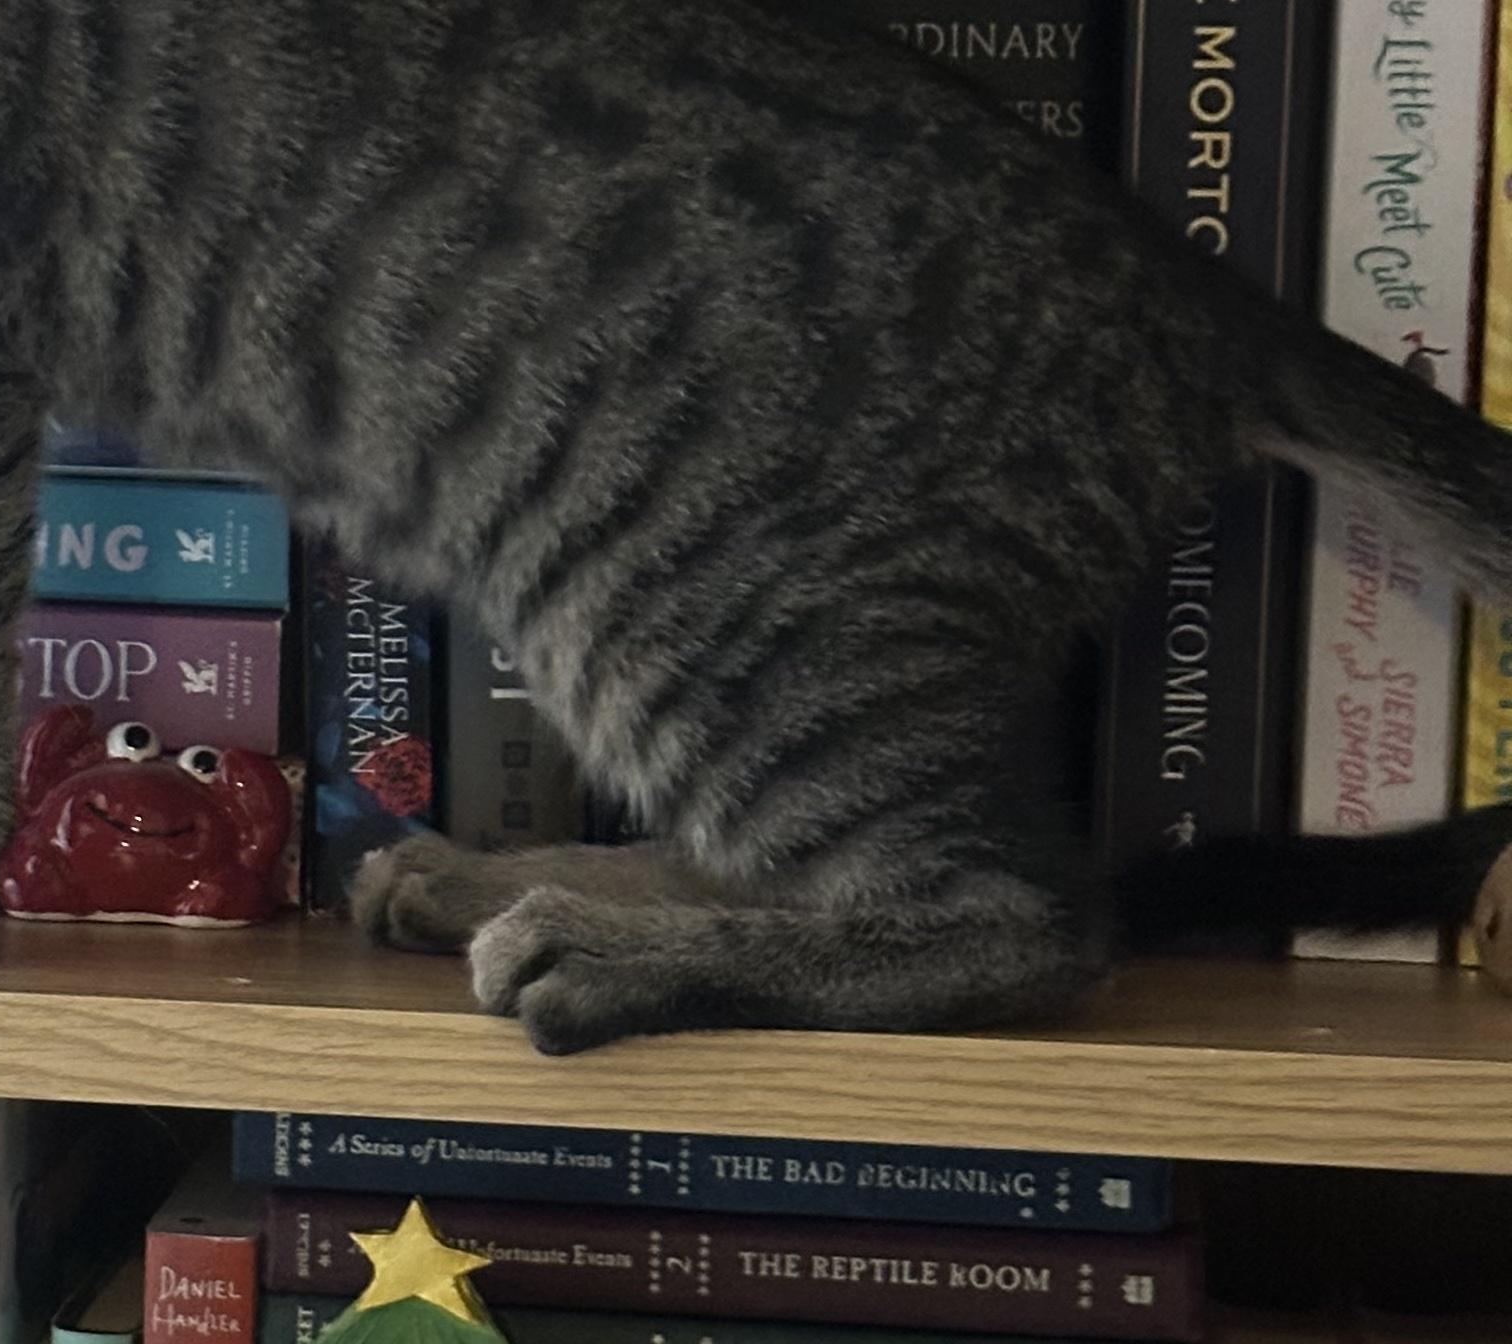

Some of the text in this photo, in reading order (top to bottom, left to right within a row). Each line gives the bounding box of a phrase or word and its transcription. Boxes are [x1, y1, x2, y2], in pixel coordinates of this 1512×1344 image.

[1373, 36, 1435, 132] Little
[1360, 152, 1433, 237] Meet
[1353, 244, 1434, 312] Cute
[345, 577, 377, 776] McTERNAN
[381, 604, 409, 748] MELISSA
[738, 1251, 1051, 1293] THE REPTILE ROOM
